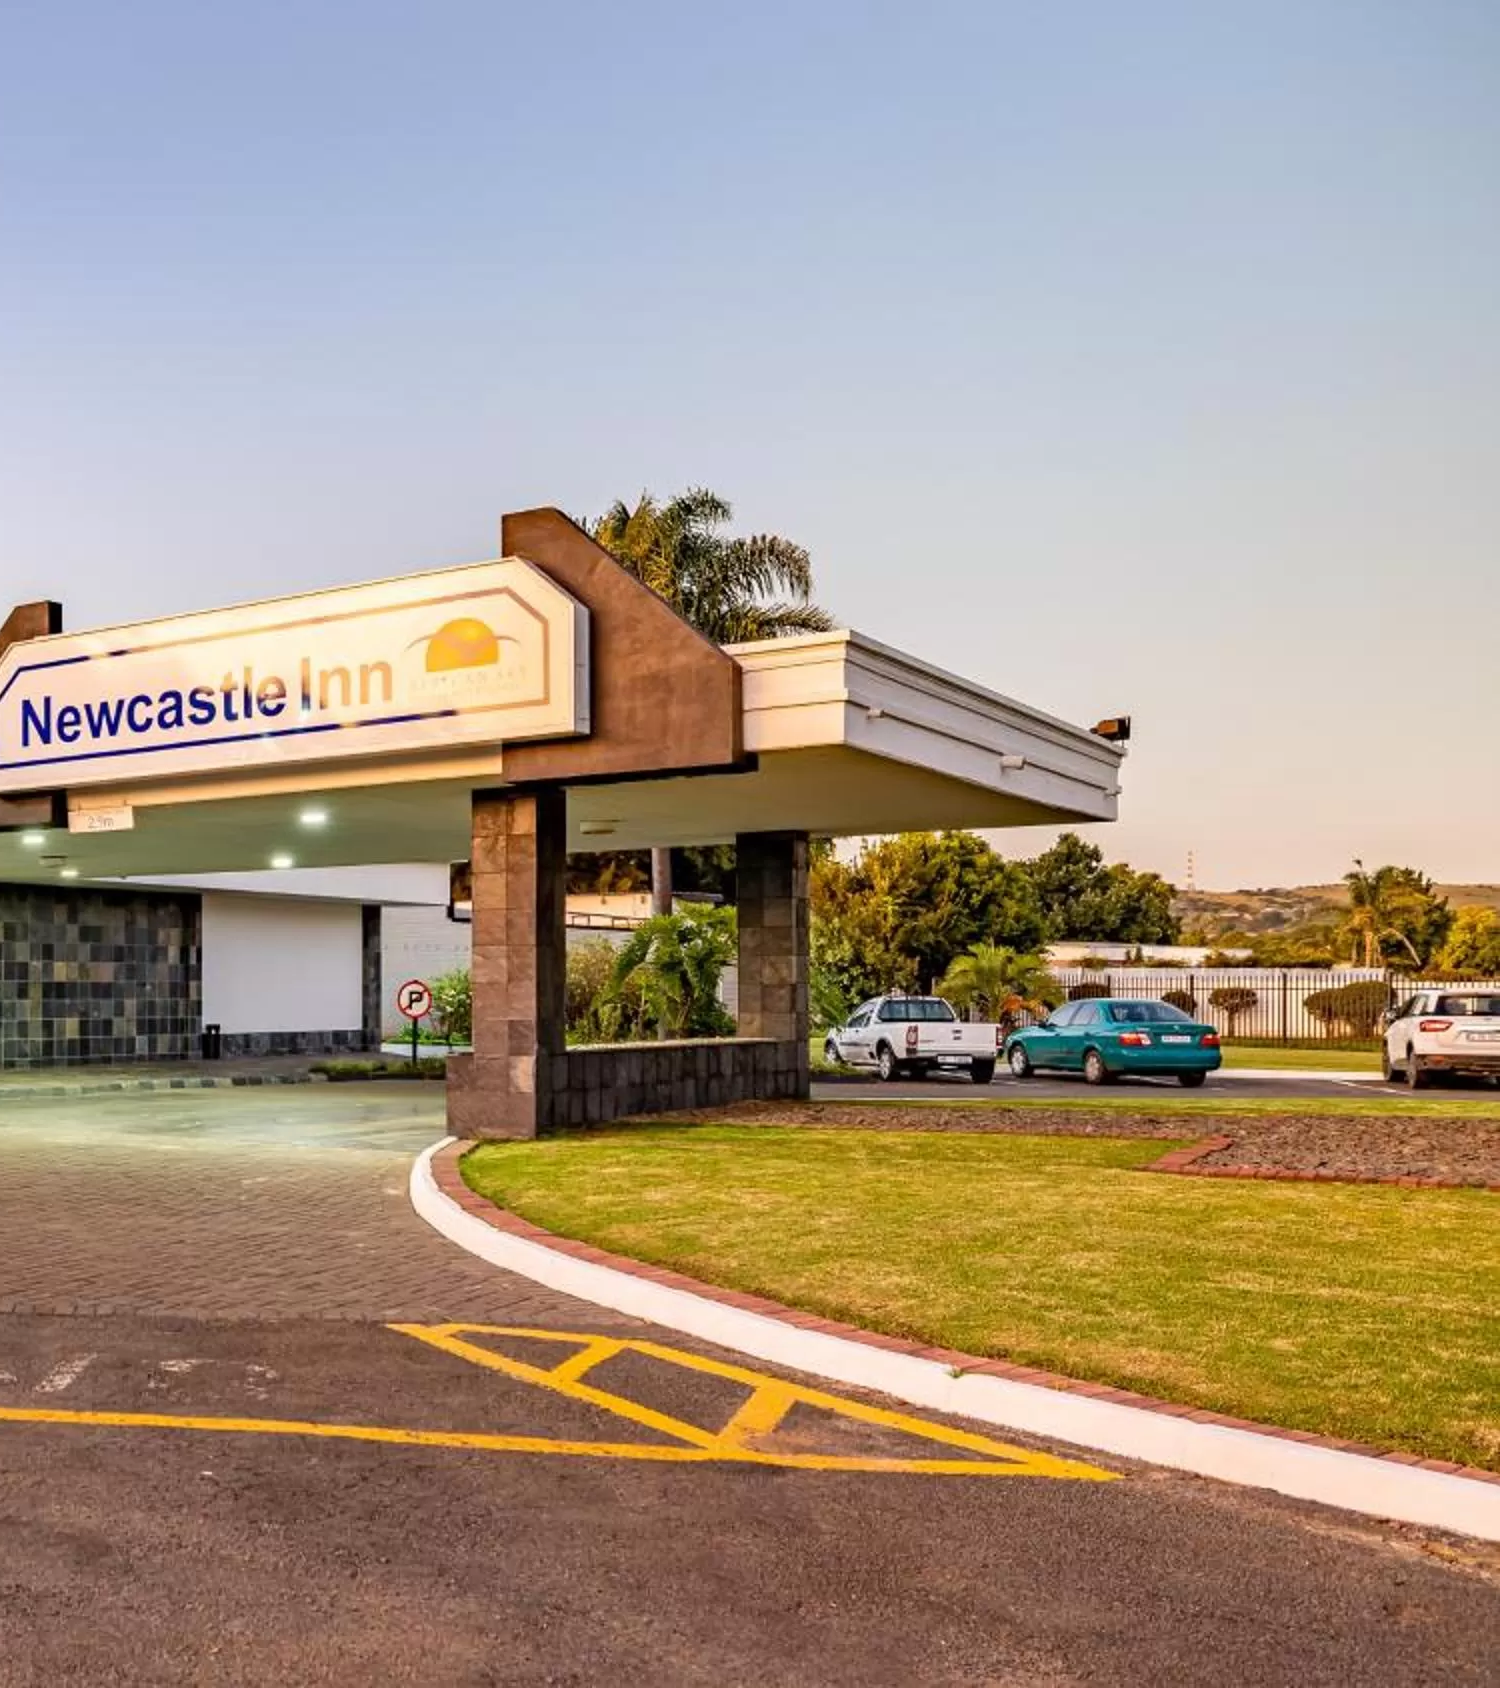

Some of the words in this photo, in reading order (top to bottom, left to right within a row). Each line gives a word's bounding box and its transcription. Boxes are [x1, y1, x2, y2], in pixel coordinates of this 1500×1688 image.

[20, 666, 287, 748] Newcastle
[300, 656, 393, 711] Inn
[409, 990, 423, 1011] P
